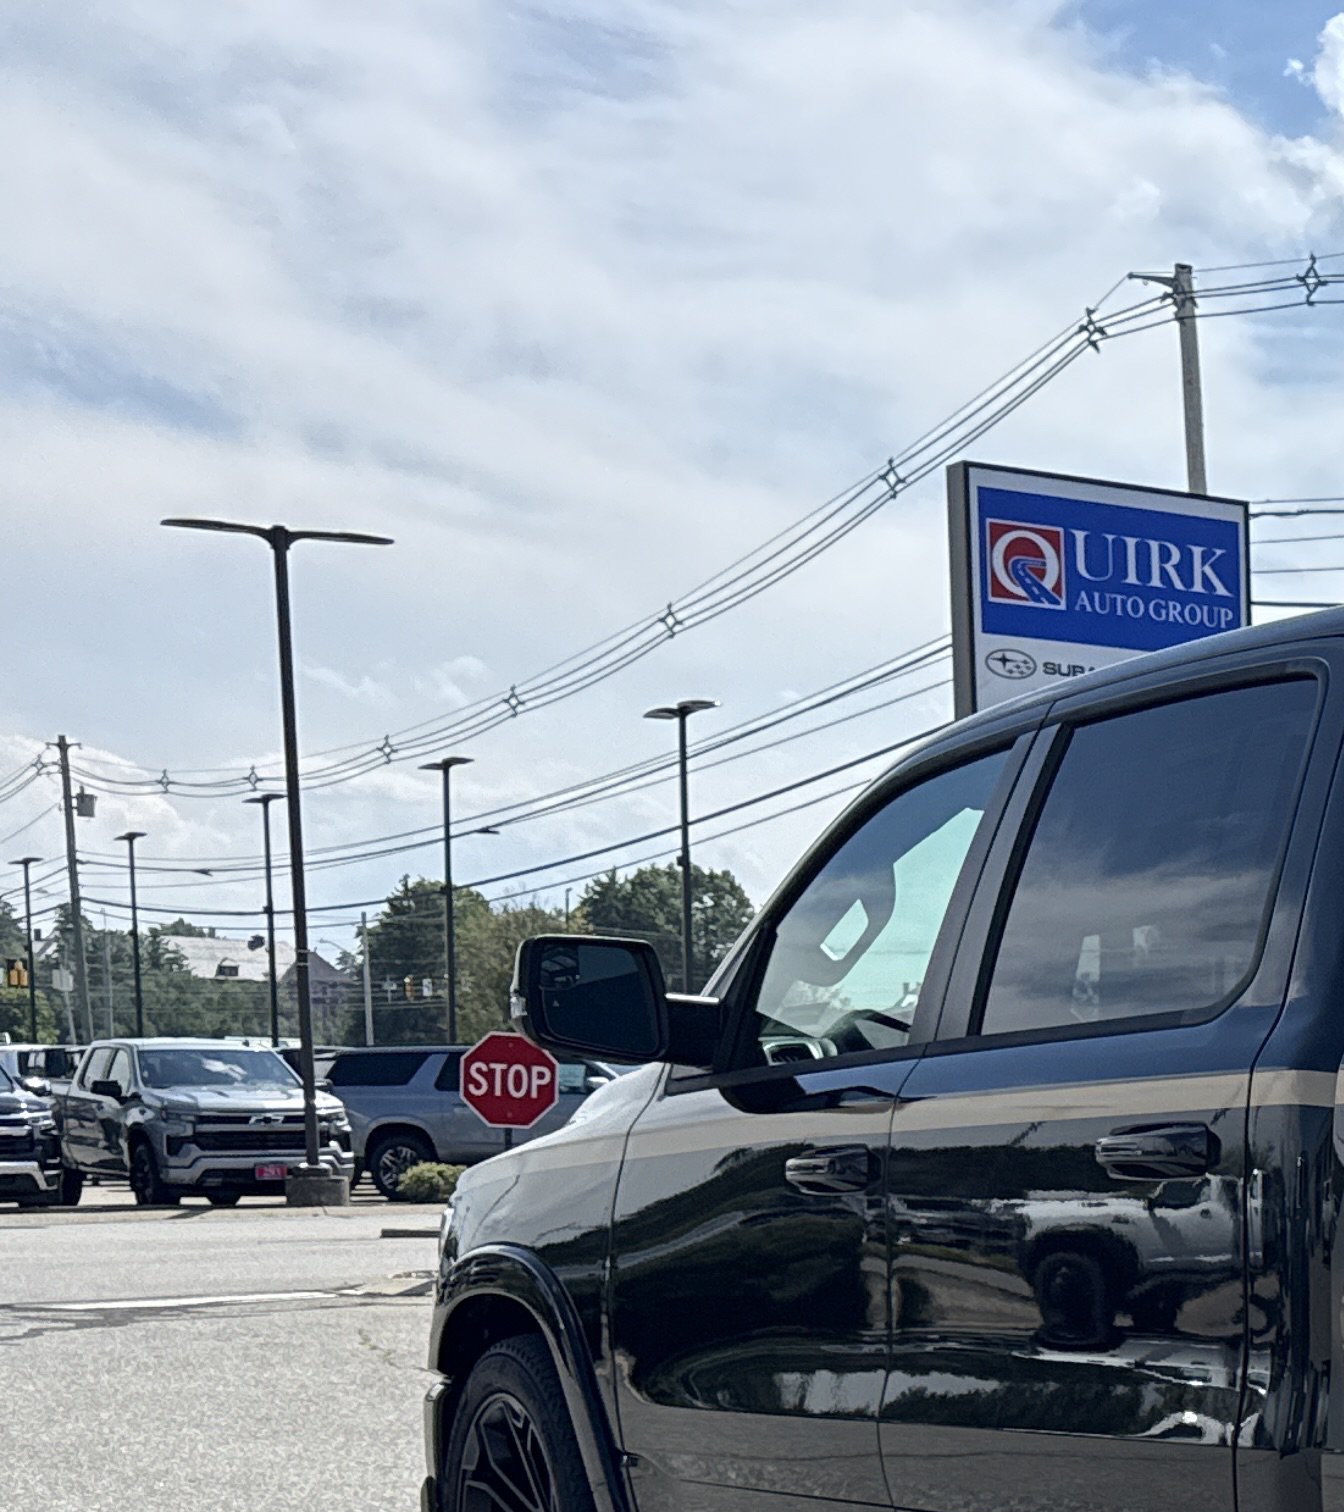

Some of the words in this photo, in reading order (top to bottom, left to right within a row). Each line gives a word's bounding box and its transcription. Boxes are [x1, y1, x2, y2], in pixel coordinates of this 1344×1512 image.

[991, 529, 1235, 603] QUIRK
[1074, 590, 1145, 618] AUTO
[1148, 599, 1233, 629] GROUP
[1042, 661, 1095, 677] SUB
[468, 1062, 551, 1099] STOP
